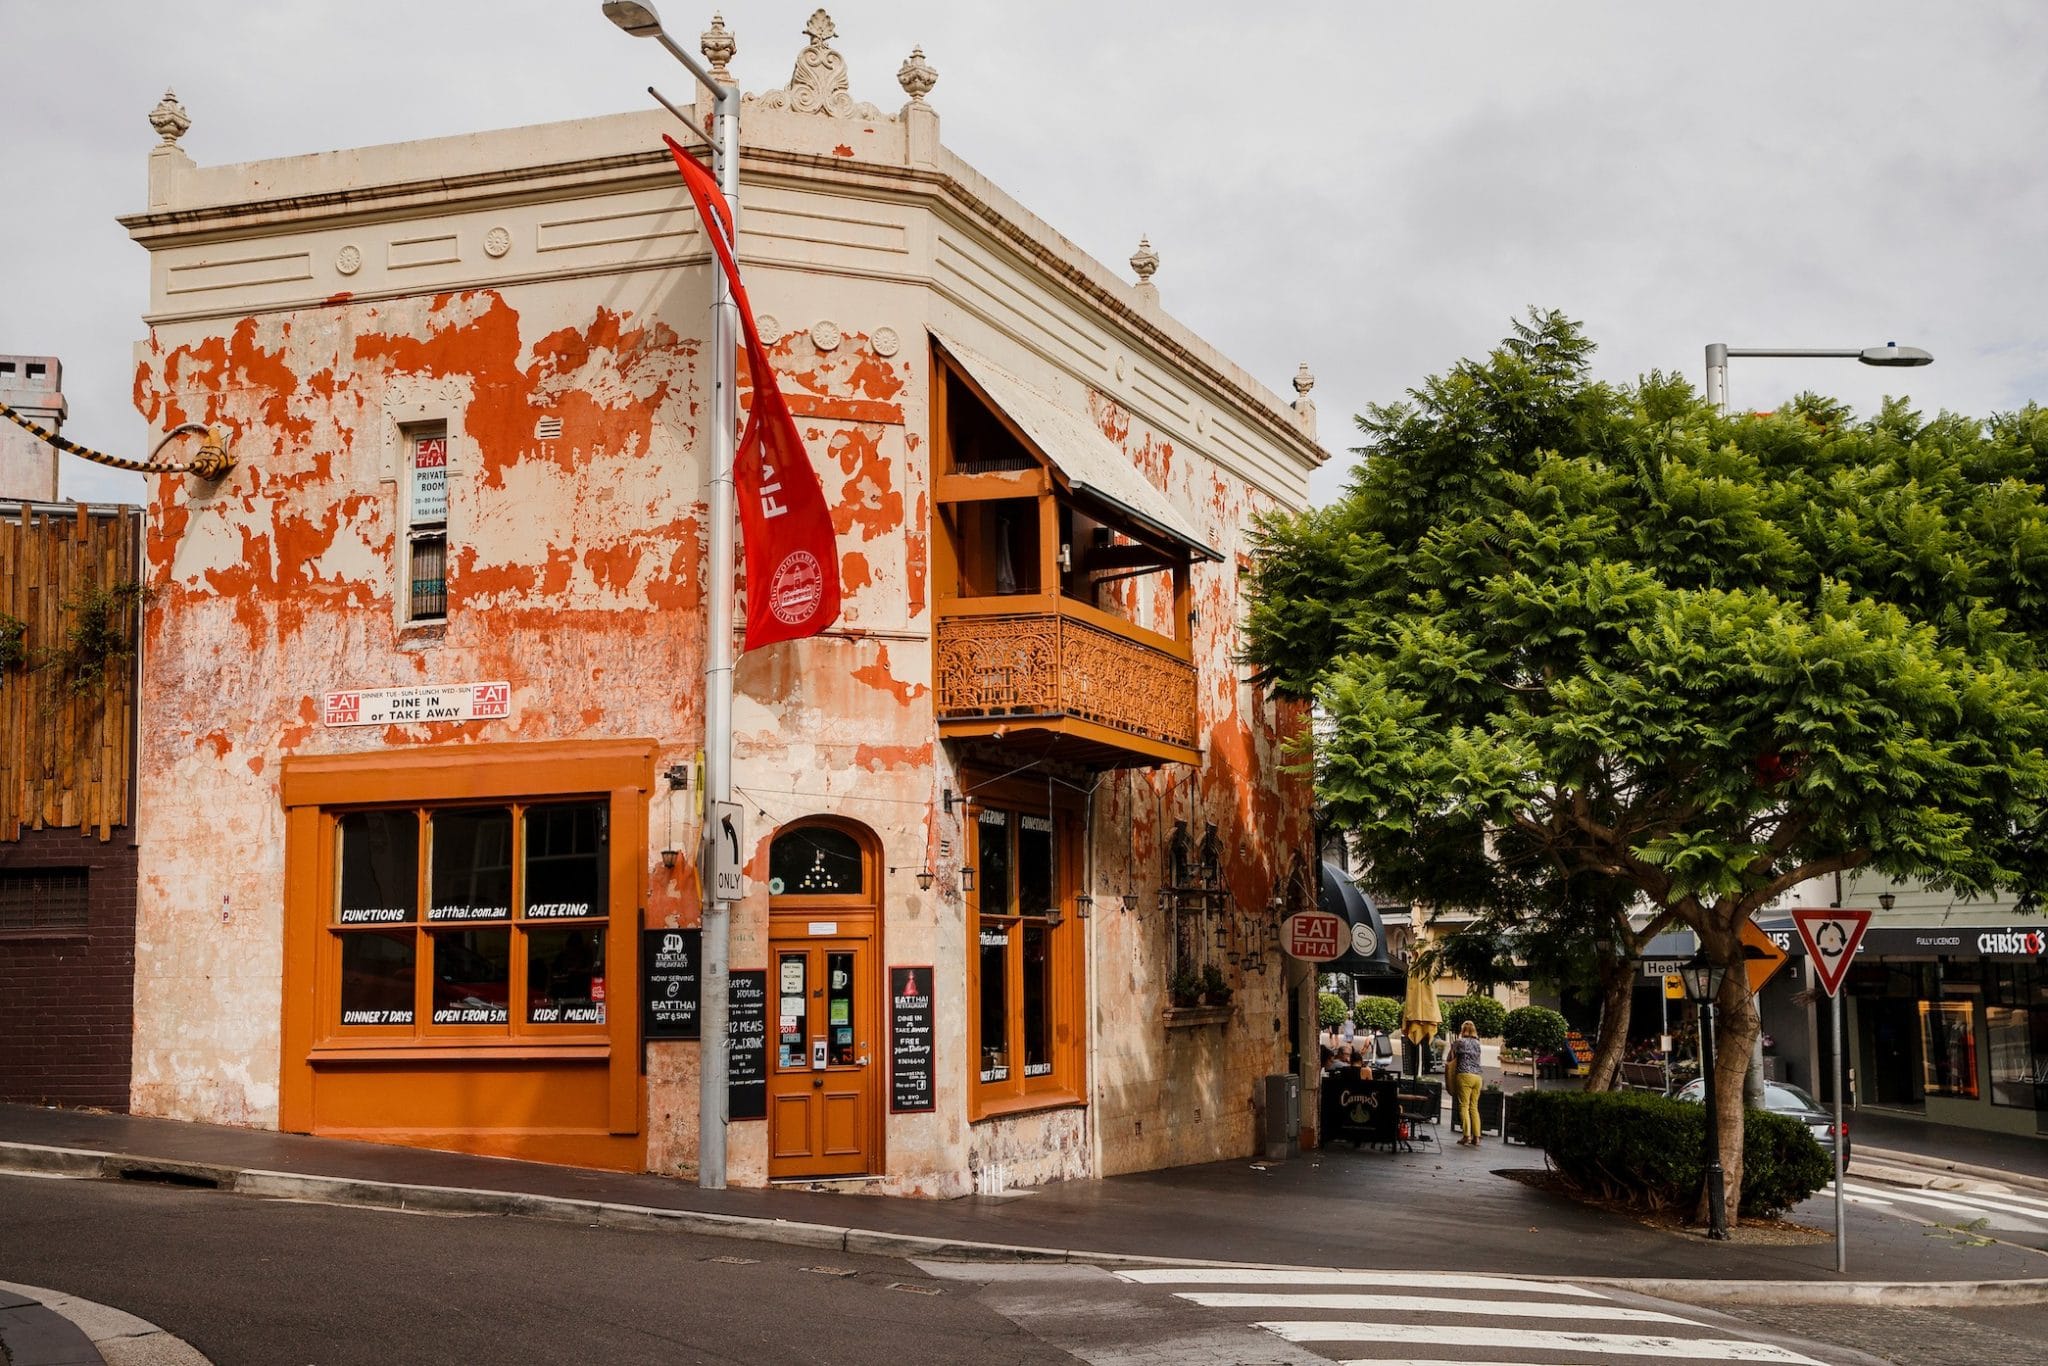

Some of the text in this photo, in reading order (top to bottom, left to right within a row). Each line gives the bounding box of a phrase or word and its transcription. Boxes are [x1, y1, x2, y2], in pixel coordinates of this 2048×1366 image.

[417, 439, 447, 455] EAT
[417, 457, 445, 467] THA
[417, 471, 447, 481] PRIVATE
[421, 482, 444, 491] ROOM
[473, 685, 507, 701] EAT
[328, 694, 359, 709] EAT
[392, 697, 440, 708] DINE IN
[371, 707, 460, 721] or TAKE AWAY
[473, 704, 507, 715] THAI
[327, 712, 359, 722] THAI
[979, 810, 1005, 826] ATERING
[718, 872, 741, 889] ONLY
[342, 908, 405, 922] FUNCTIONS
[428, 905, 507, 919] eatthai.com.au
[528, 903, 589, 917] CATERING
[1294, 918, 1336, 938] EAT
[1916, 937, 1961, 946] FULLY LICENCED
[1293, 942, 1336, 955] THAI
[344, 1010, 413, 1023] DINNER 7 DAYS
[434, 1009, 461, 1022] OPEN
[461, 1010, 489, 1022] FROM
[533, 1008, 559, 1021] KIDS
[564, 1008, 599, 1021] MENU
[656, 1013, 670, 1021] SAT
[729, 1021, 738, 1033] 12
[780, 1026, 797, 1034] 2017
